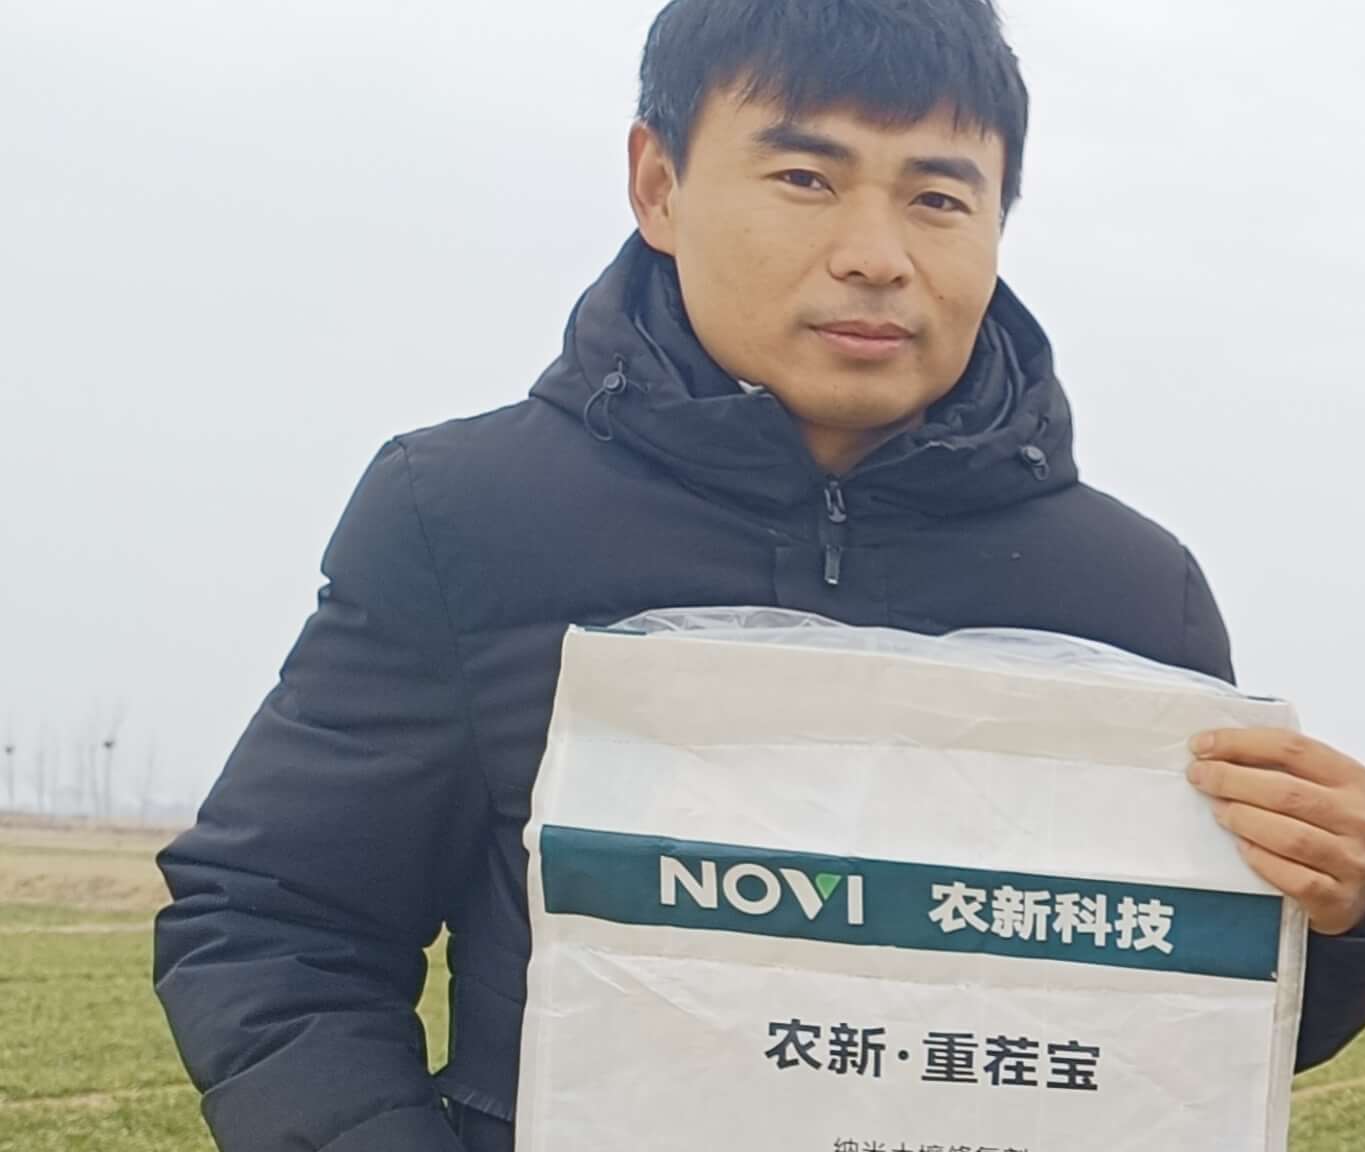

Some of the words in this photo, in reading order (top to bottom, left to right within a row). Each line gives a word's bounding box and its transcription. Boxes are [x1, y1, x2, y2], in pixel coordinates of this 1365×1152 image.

[658, 854, 864, 926] NOVI
[927, 880, 1175, 955] 农新科技
